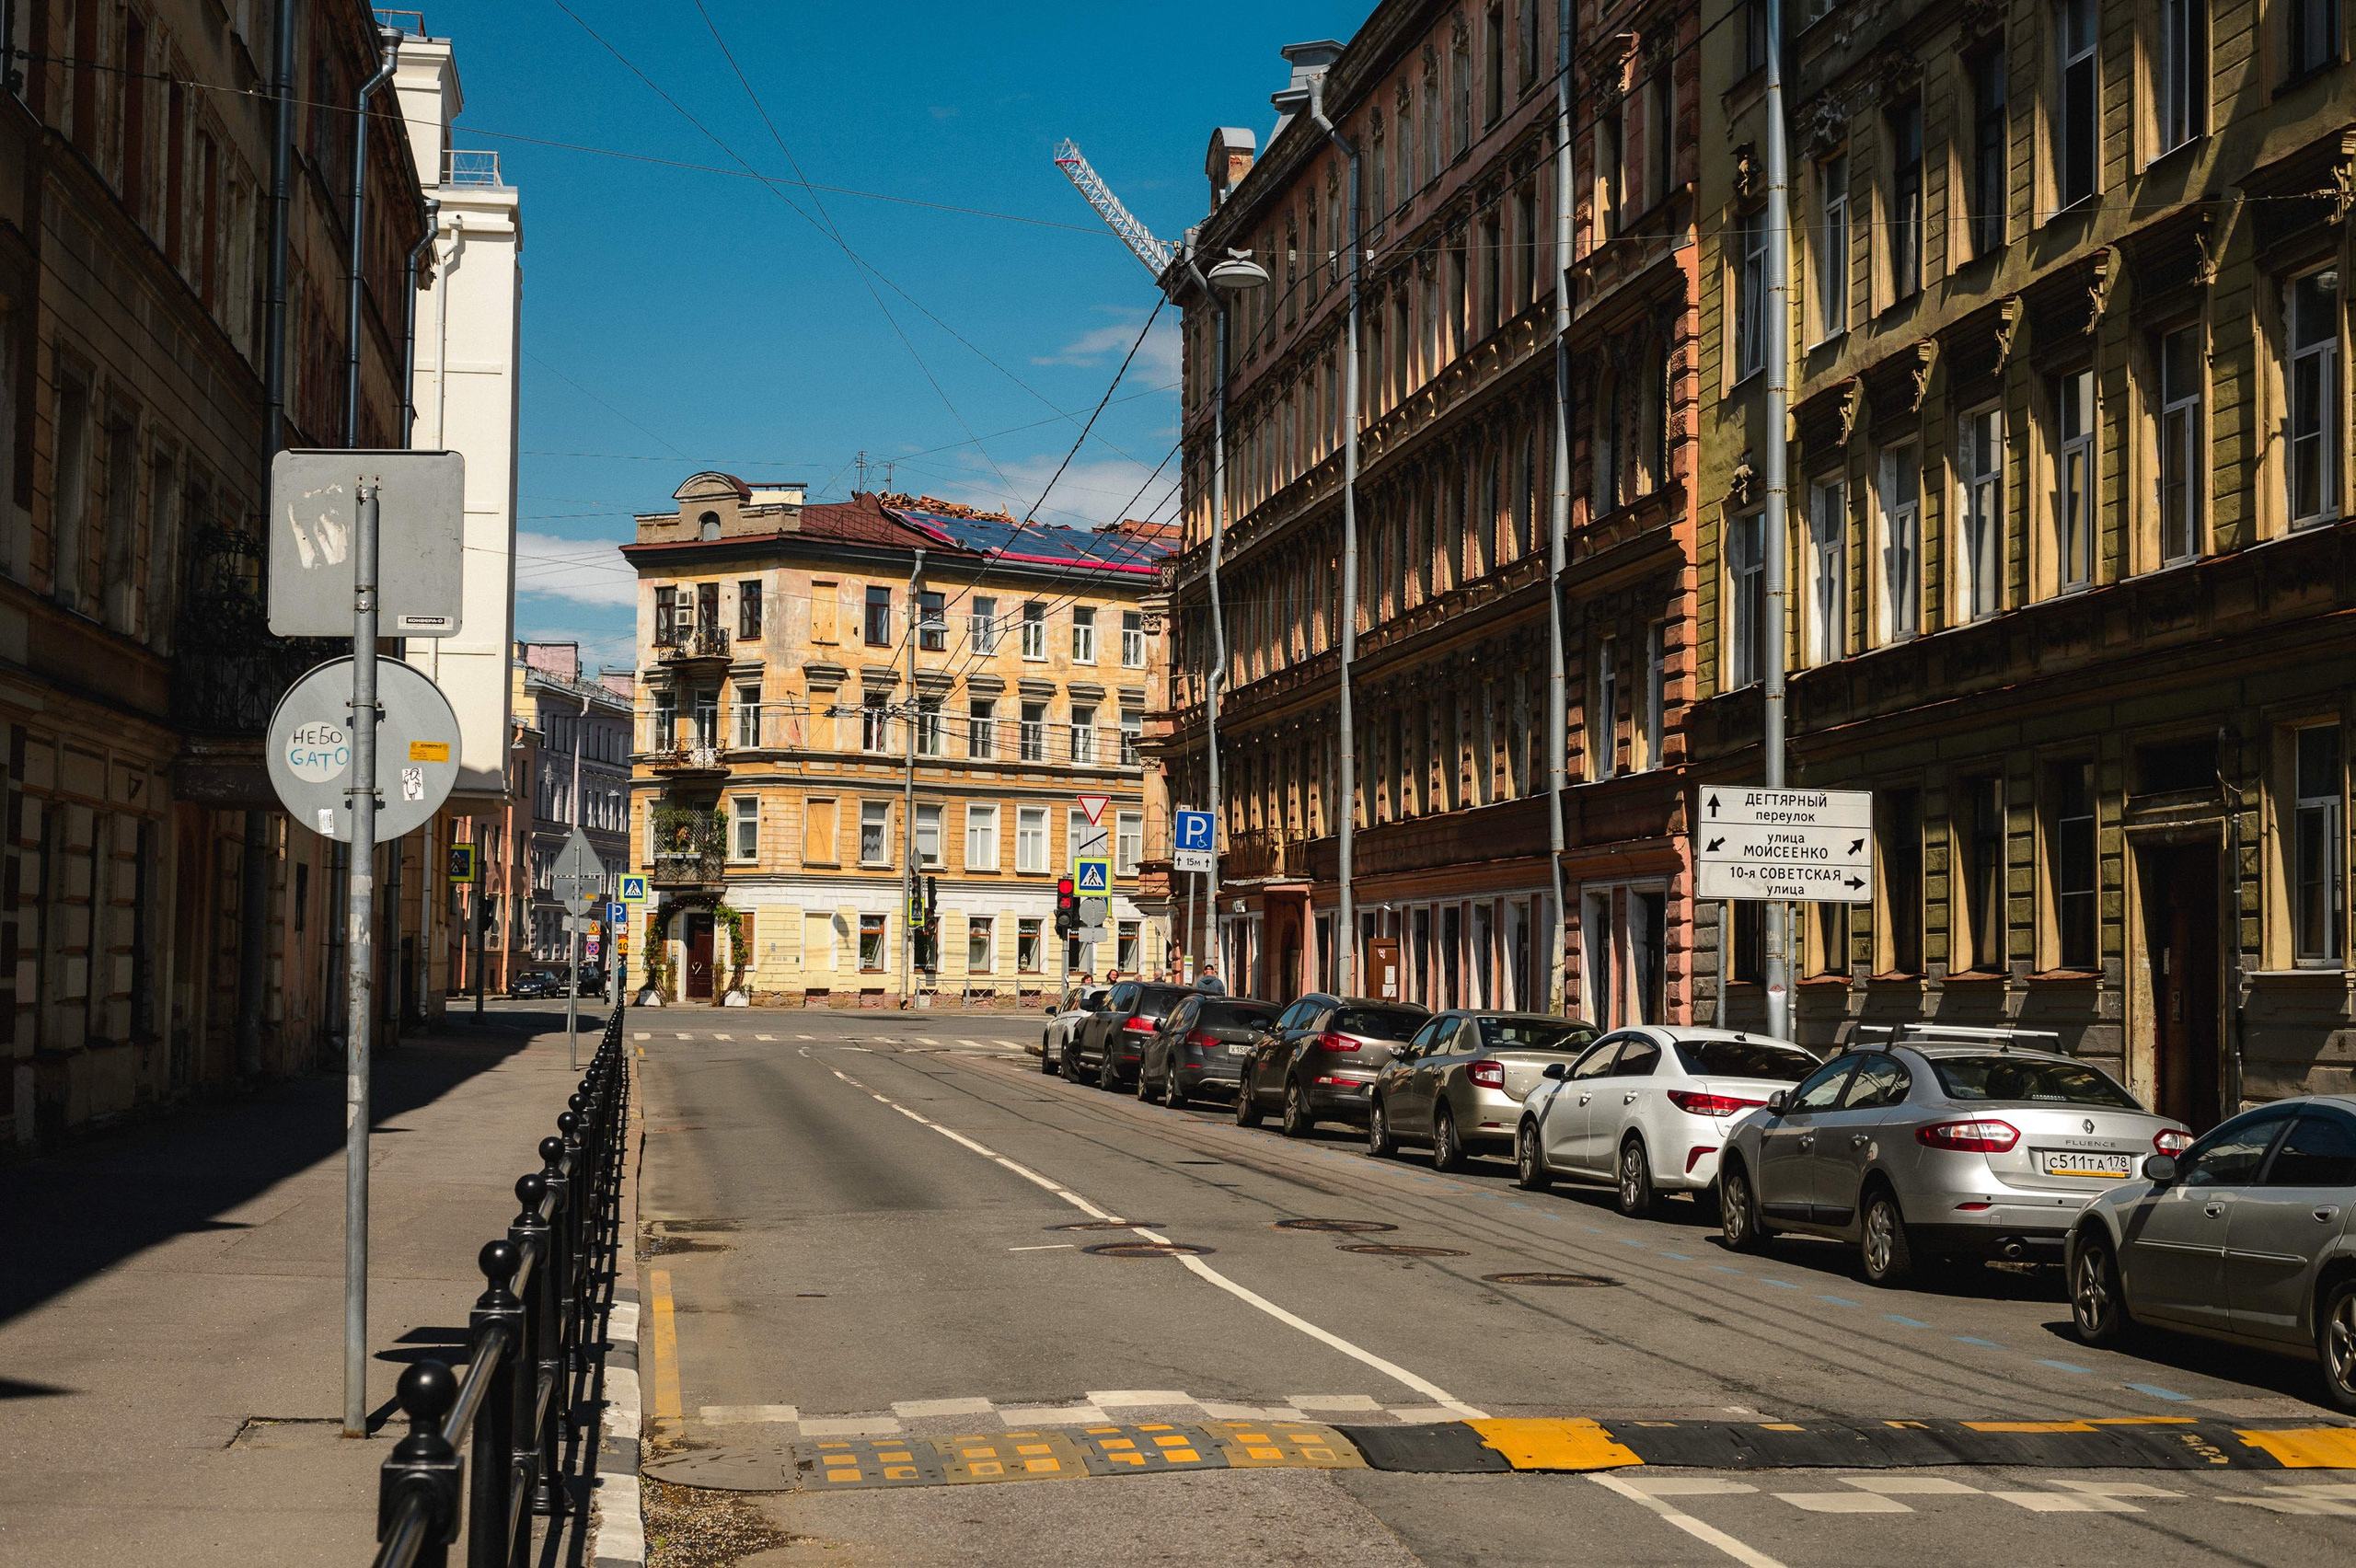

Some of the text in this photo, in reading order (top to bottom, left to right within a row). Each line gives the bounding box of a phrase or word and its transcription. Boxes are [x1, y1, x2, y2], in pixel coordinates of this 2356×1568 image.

[294, 726, 342, 744] НЕБО
[290, 746, 350, 771] GATO
[1745, 792, 1827, 807] ДЕГТЯРНЫЙ
[1756, 811, 1815, 824] переулок
[1767, 833, 1805, 845] улица
[1744, 845, 1828, 859] МОИСЕЕНКО
[1730, 866, 1841, 881] 10-я СОВЕТСКАЯ
[1766, 884, 1805, 896] улица
